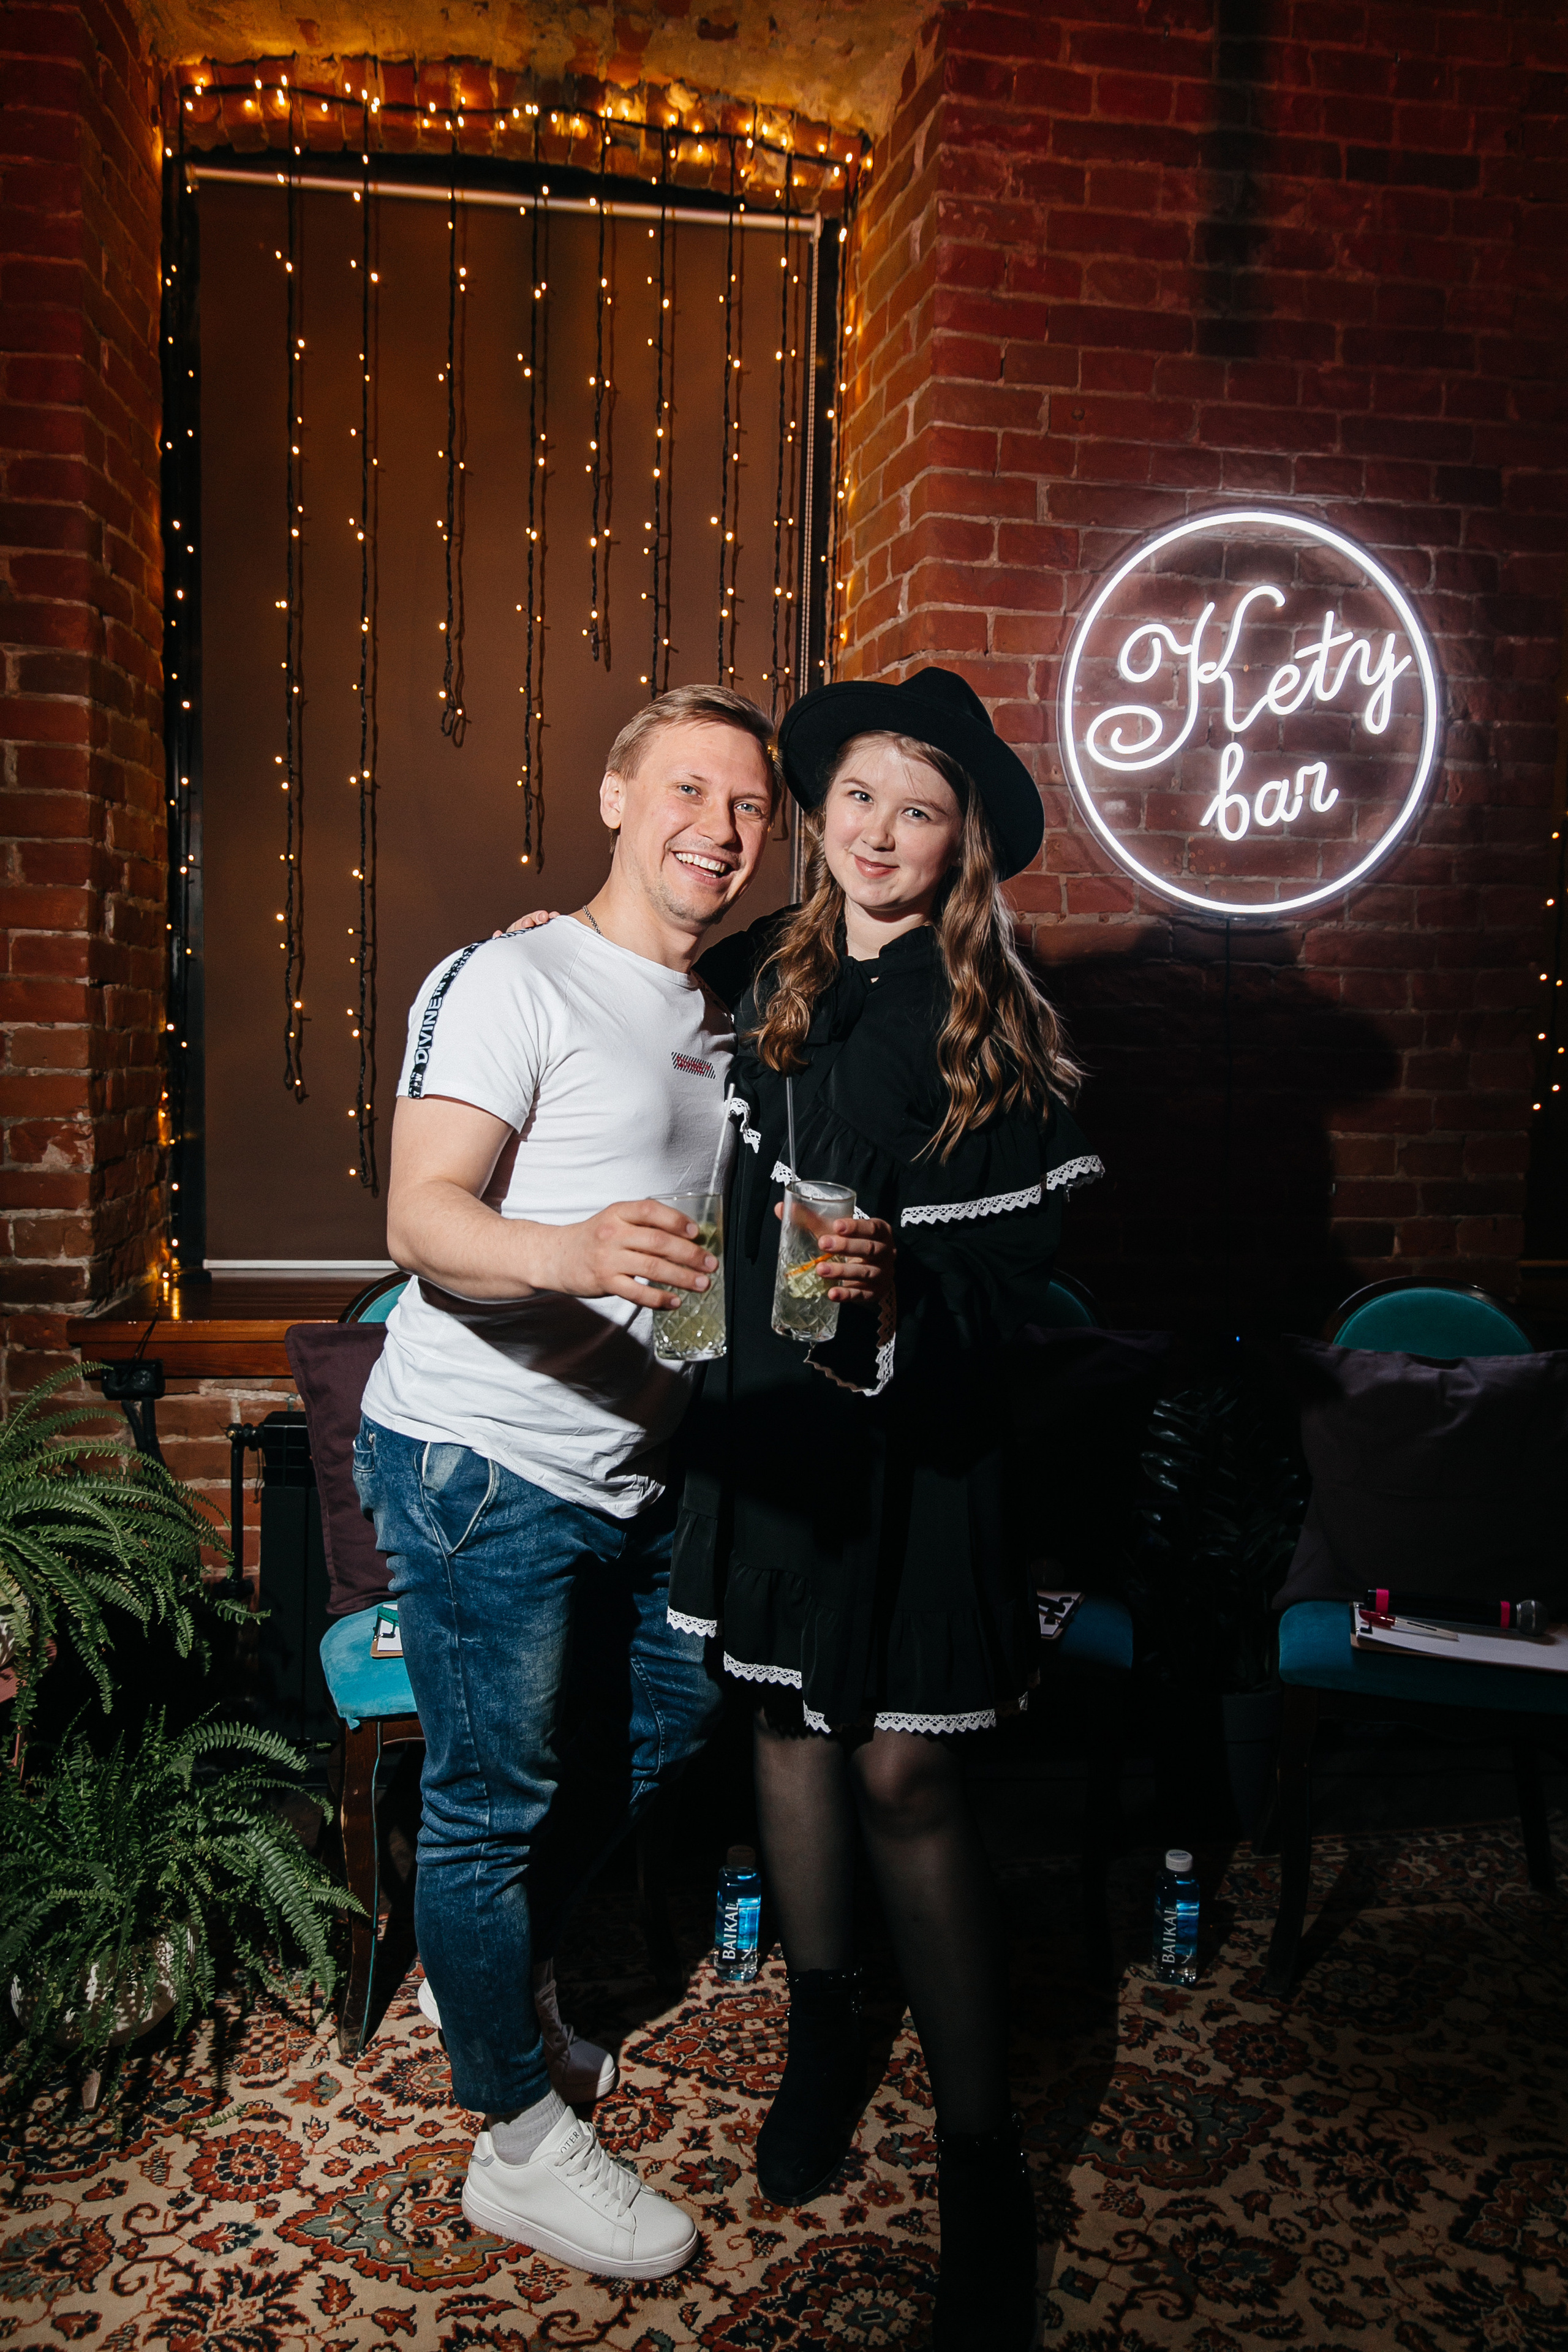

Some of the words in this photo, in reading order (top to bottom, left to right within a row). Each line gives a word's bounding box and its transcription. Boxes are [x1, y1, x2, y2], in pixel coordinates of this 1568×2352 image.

[1085, 585, 1412, 772] Kety
[1199, 741, 1340, 842] bar
[415, 997, 442, 1065] DIVINE
[722, 1902, 739, 1959] BAIKAL
[1162, 1906, 1177, 1964] BAIKAL
